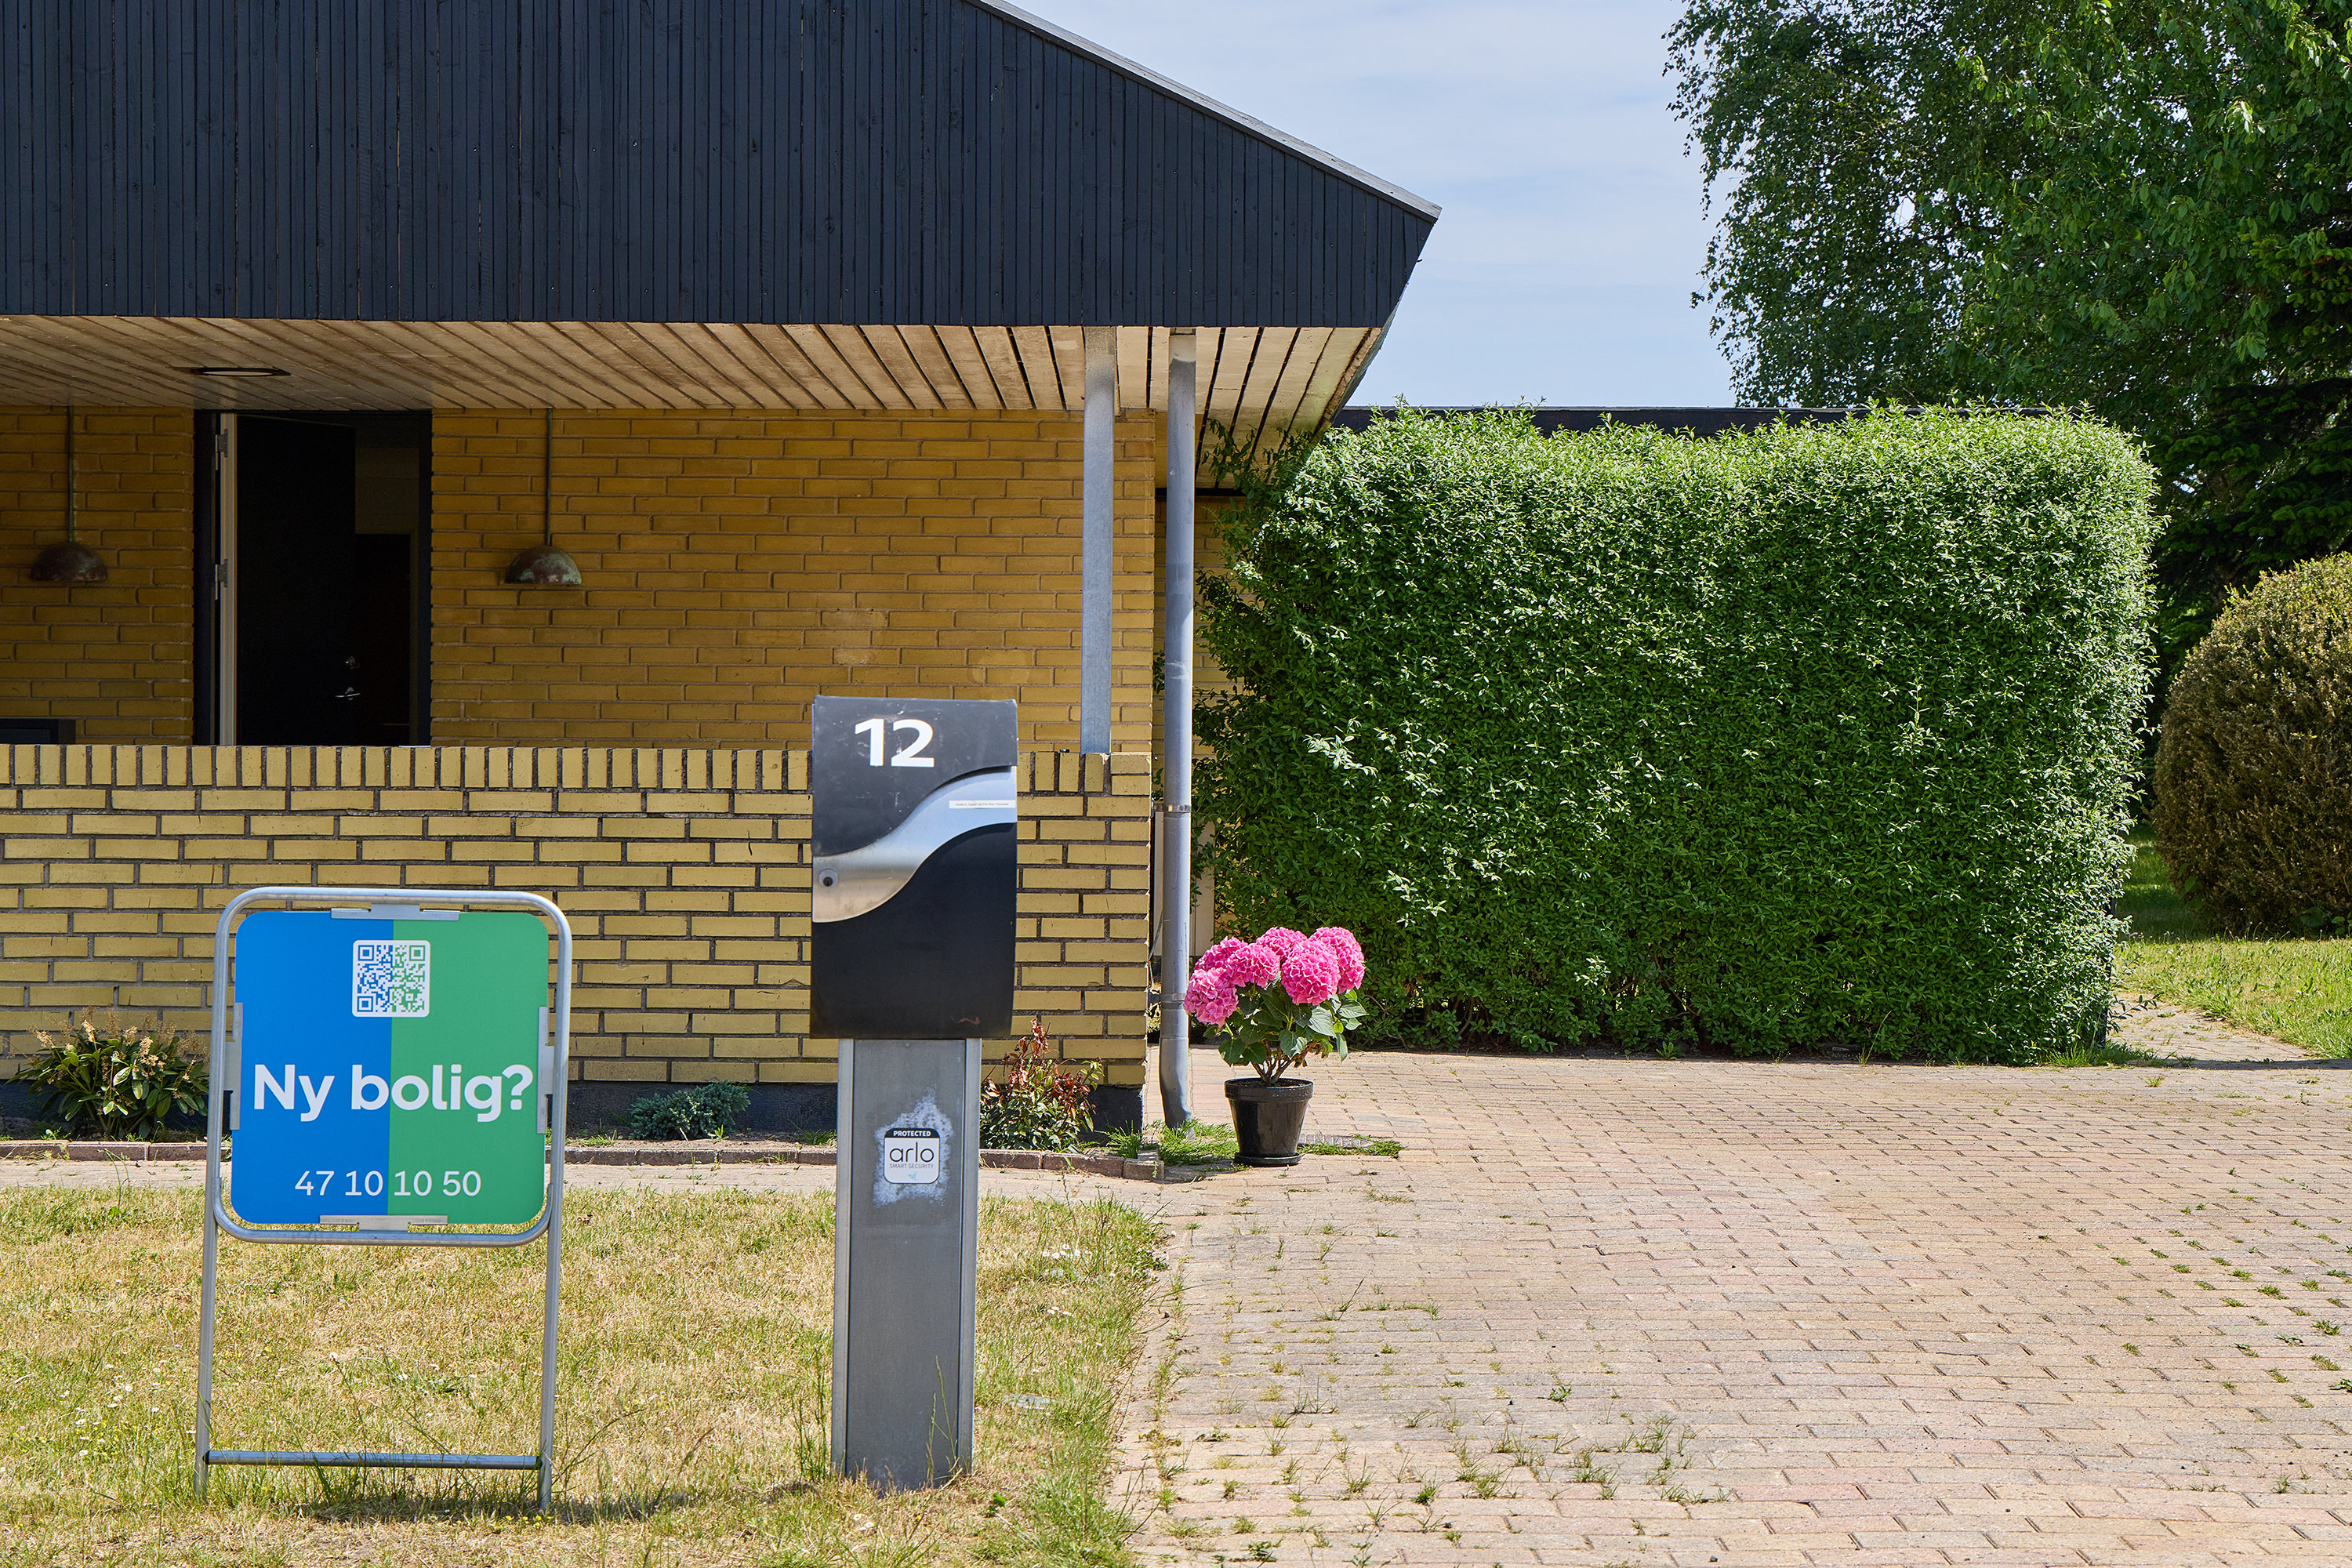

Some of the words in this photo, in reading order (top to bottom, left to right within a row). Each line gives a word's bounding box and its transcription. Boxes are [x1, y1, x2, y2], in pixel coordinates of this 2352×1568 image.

[855, 717, 935, 768] 12
[253, 1064, 335, 1122] Ny
[351, 1063, 534, 1123] bolig?
[889, 1142, 935, 1163] arlo
[295, 1171, 335, 1196] 47
[345, 1171, 383, 1196] 10
[394, 1171, 433, 1196] 10
[442, 1171, 481, 1196] 50
